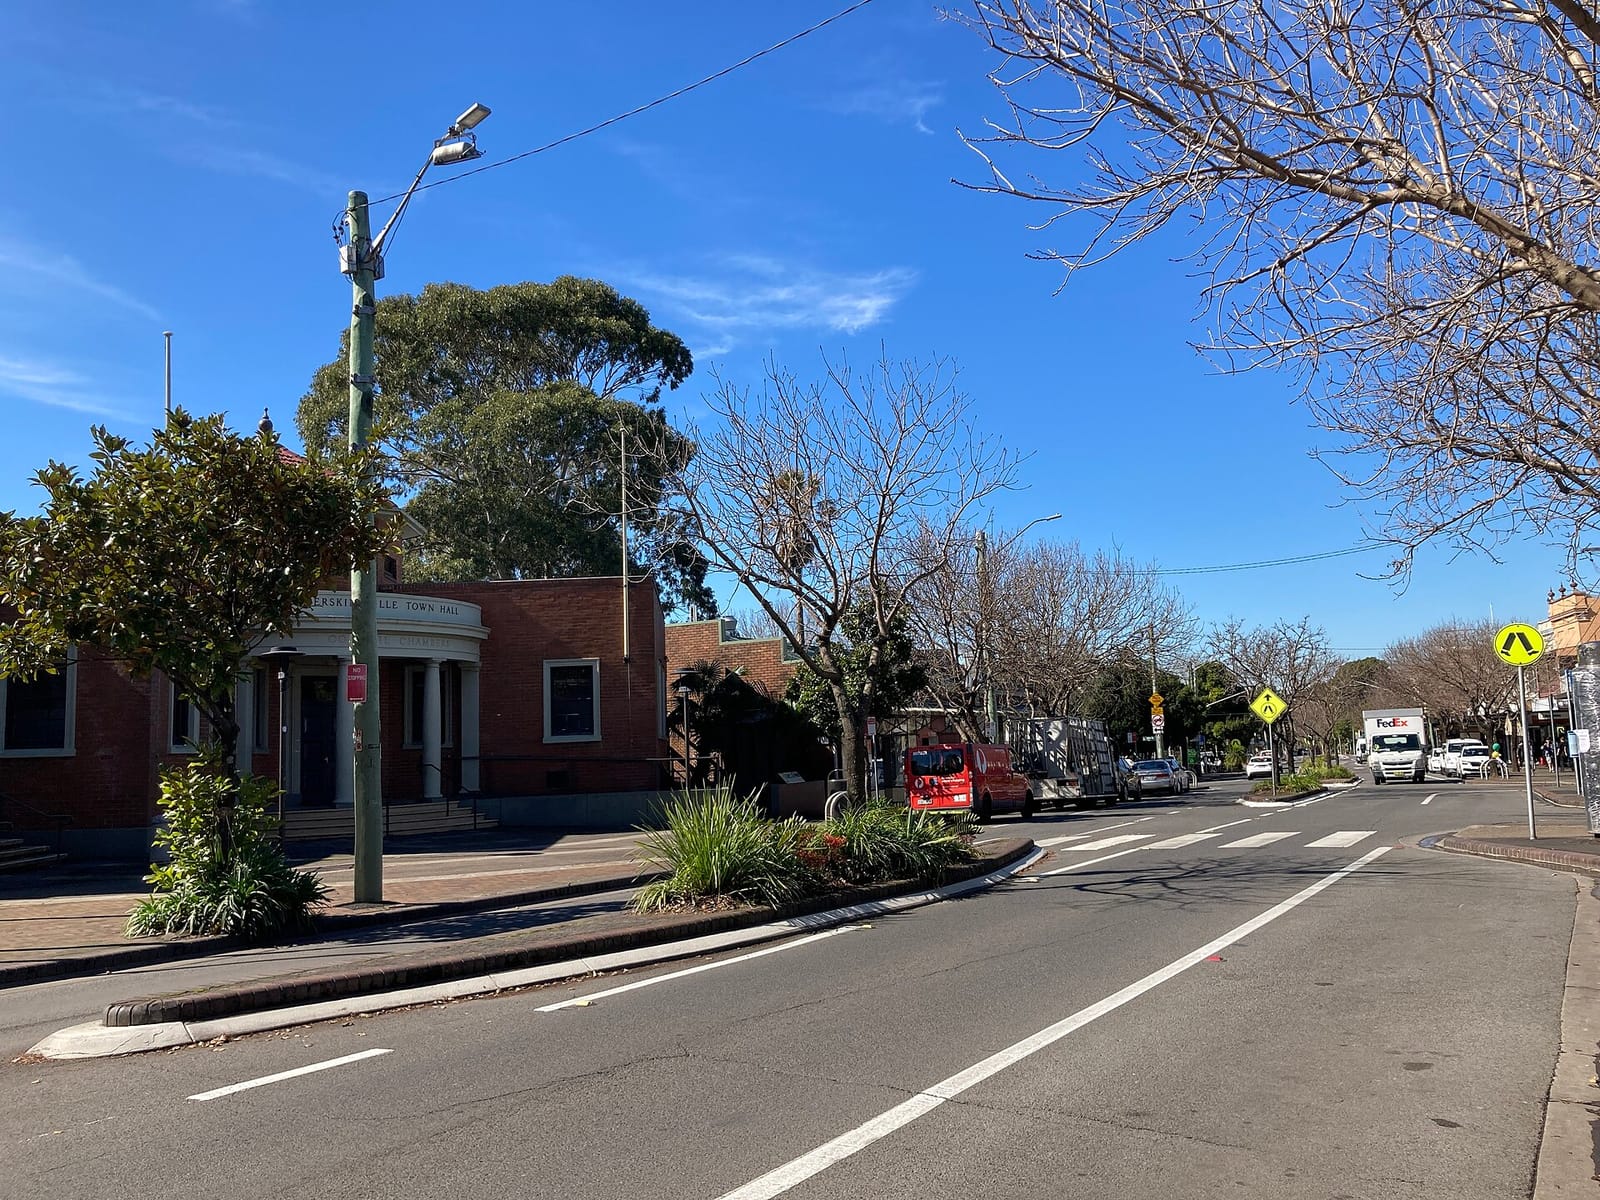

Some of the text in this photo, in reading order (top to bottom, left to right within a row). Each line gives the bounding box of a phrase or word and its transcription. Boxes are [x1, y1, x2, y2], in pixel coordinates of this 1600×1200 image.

[407, 602, 434, 611] TOWN
[440, 605, 459, 615] HALL
[1377, 718, 1408, 728] FedEx
